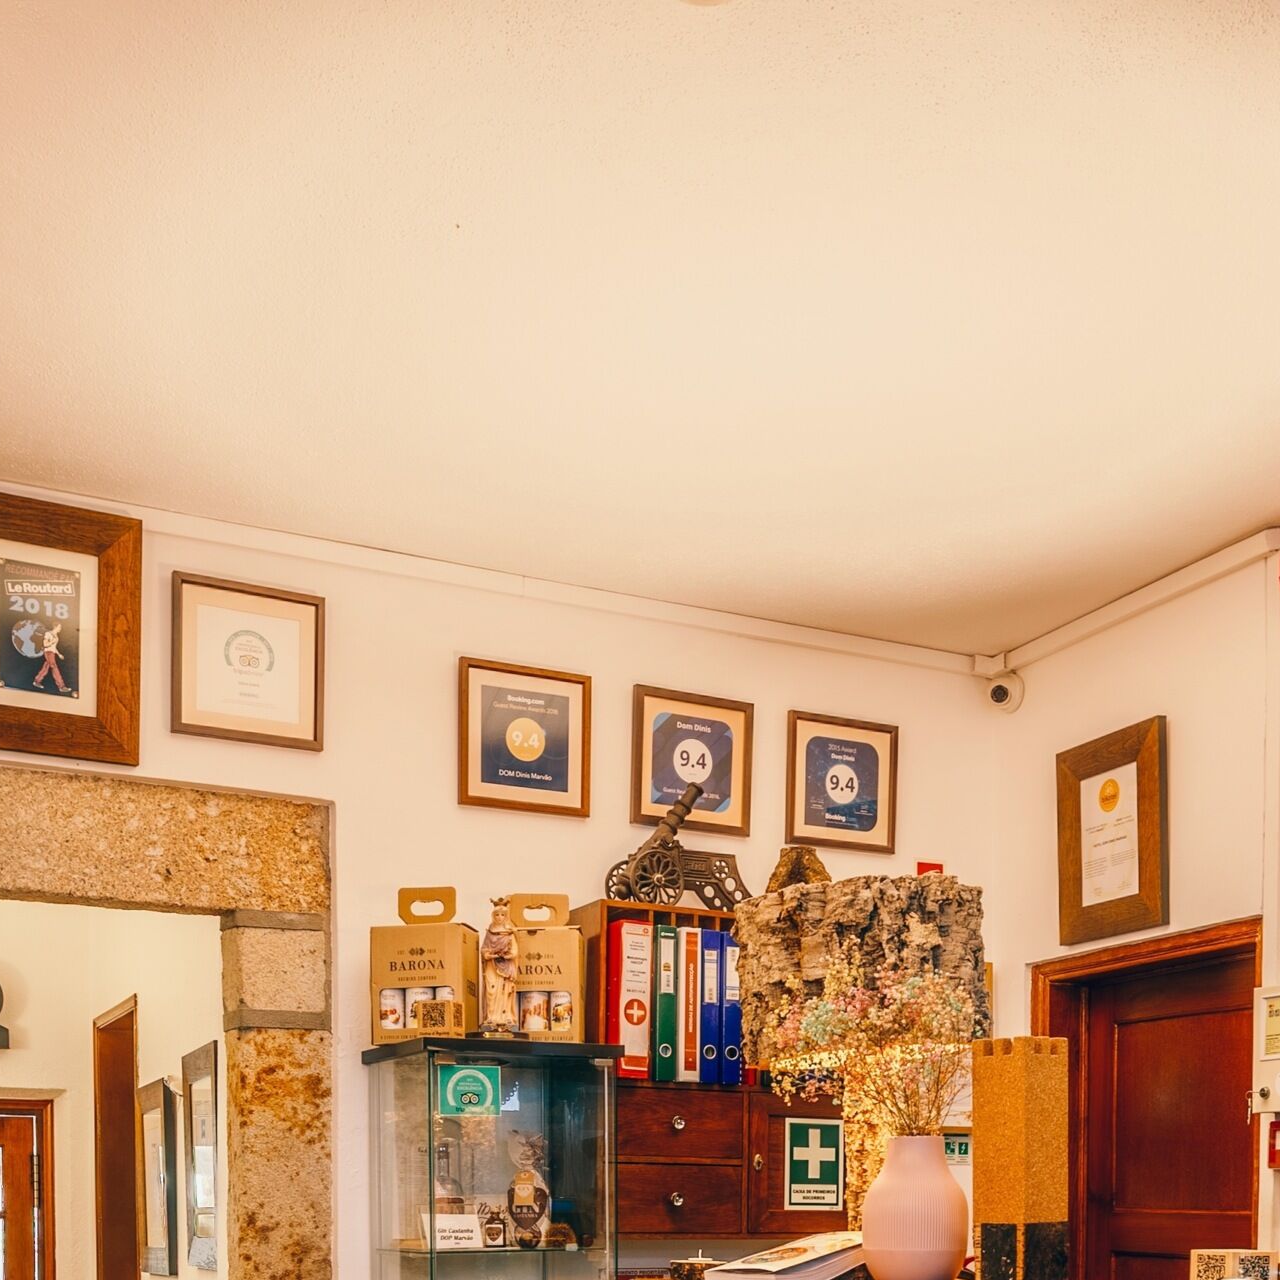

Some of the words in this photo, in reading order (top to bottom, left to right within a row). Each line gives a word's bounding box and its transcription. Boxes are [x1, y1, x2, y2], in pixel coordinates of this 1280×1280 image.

[7, 582, 22, 593] Le
[22, 583, 73, 594] Routard
[9, 596, 69, 619] 2018
[511, 730, 540, 749] 9.4
[679, 750, 707, 770] 9.4
[829, 774, 856, 793] 9.4
[389, 959, 445, 972] BARONA
[517, 964, 562, 975] ARONA
